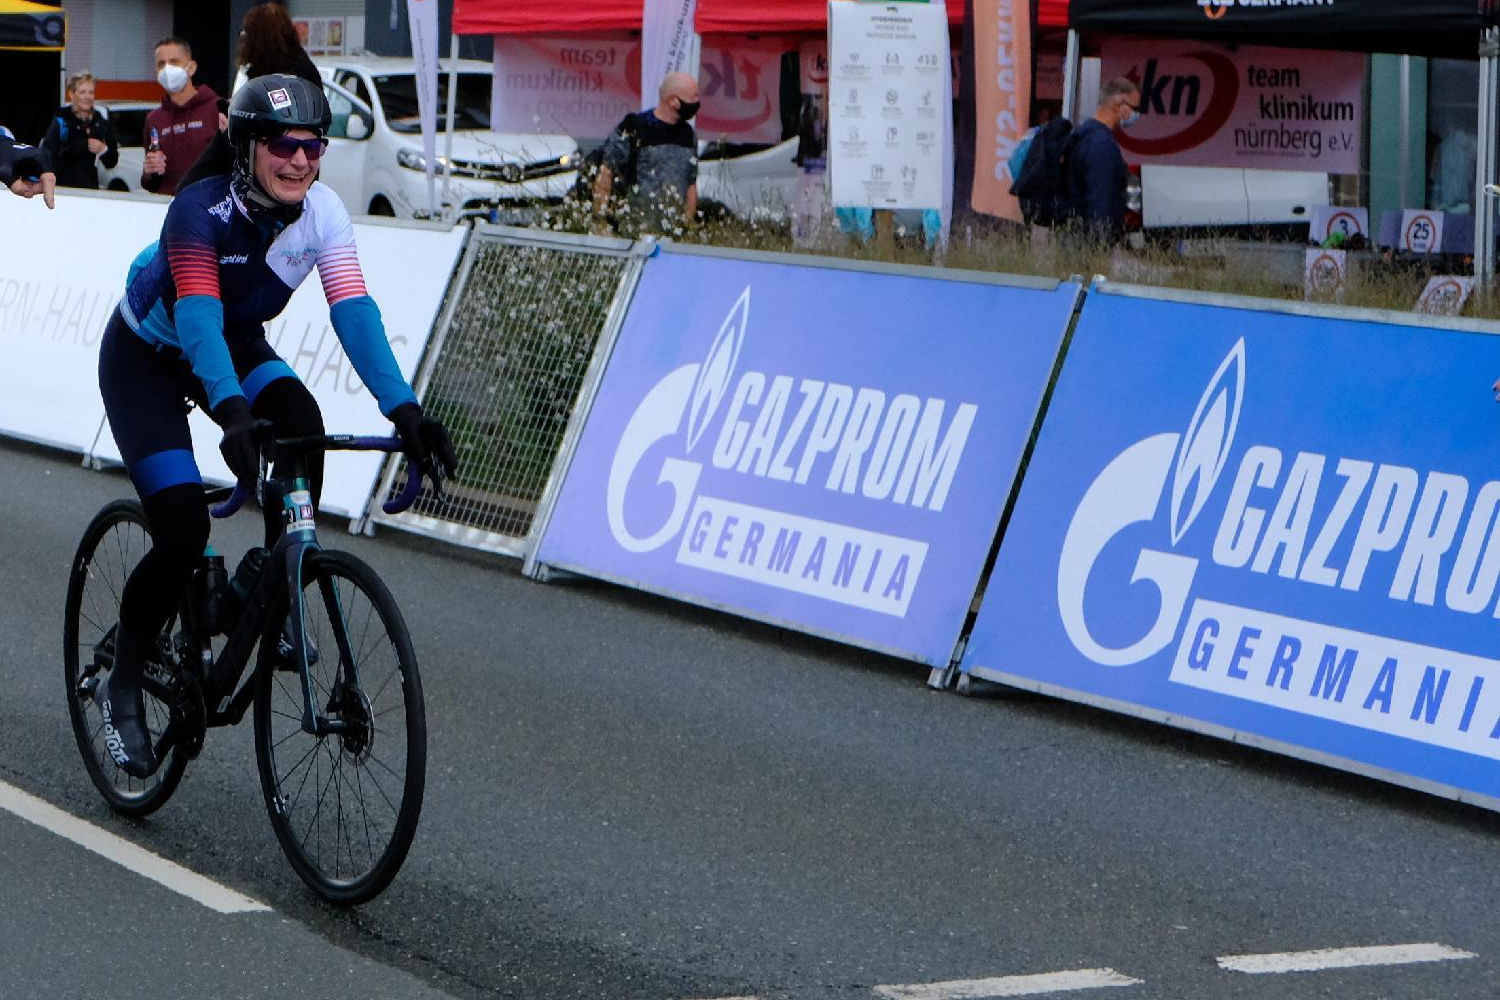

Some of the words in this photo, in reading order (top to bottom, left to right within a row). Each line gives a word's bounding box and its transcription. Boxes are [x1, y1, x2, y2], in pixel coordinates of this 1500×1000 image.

[1247, 65, 1300, 87] team
[1259, 94, 1354, 121] klinikum
[1234, 122, 1322, 157] nürnberg
[1328, 131, 1354, 150] e.V.
[1413, 223, 1429, 240] 25
[712, 371, 978, 512] GAZPROM
[688, 510, 910, 601] GERMANIA
[1212, 445, 1500, 618] GAZPRO
[1187, 618, 1500, 740] GERMANI
